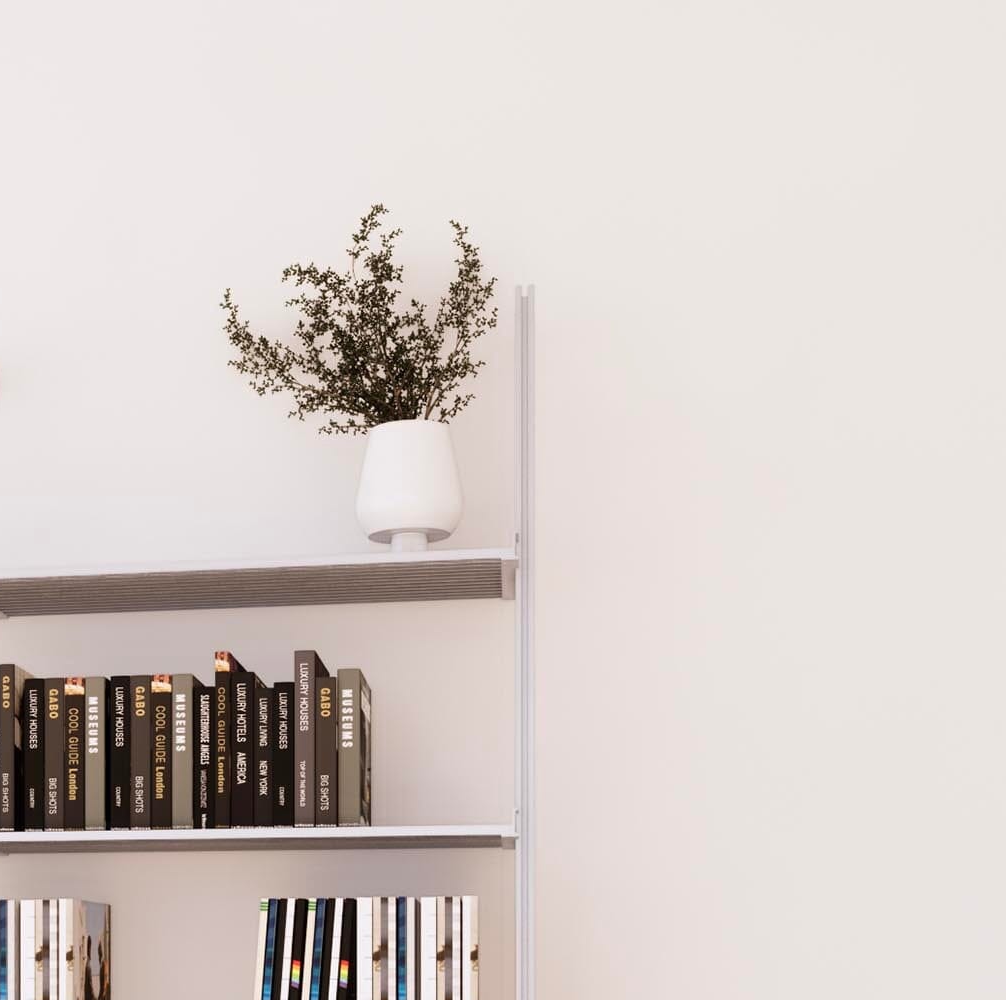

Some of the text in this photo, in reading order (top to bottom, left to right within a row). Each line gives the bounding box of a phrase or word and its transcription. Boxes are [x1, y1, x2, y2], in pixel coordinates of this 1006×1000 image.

[2, 675, 10, 709] GABO
[29, 689, 38, 750] LUXURY HOUSES
[49, 688, 58, 719] GABO
[115, 686, 124, 748] LUXURY HOUSES
[135, 686, 145, 717] GABO
[279, 692, 288, 750] LUXURY HOUSES
[300, 663, 308, 732] LUXURY HOUSES
[320, 687, 331, 717] GABO
[342, 688, 353, 748] MUSEUMS
[88, 696, 98, 754] MUSEUMS
[175, 694, 186, 752] MUSEUMS
[217, 686, 226, 794] COOL GUIDE London
[236, 683, 247, 785] LUXURY HOTELS AMERICA
[259, 698, 268, 796] LUXURY LIVING NEW YORK
[68, 707, 79, 801] COOL GUIDE London
[155, 705, 166, 800] COOL GUIDE London
[200, 745, 210, 766] ANGELS
[49, 777, 57, 815] BIG SHOTS
[135, 775, 143, 814] BIG SHOTS
[320, 774, 329, 811] BIG SHOTS
